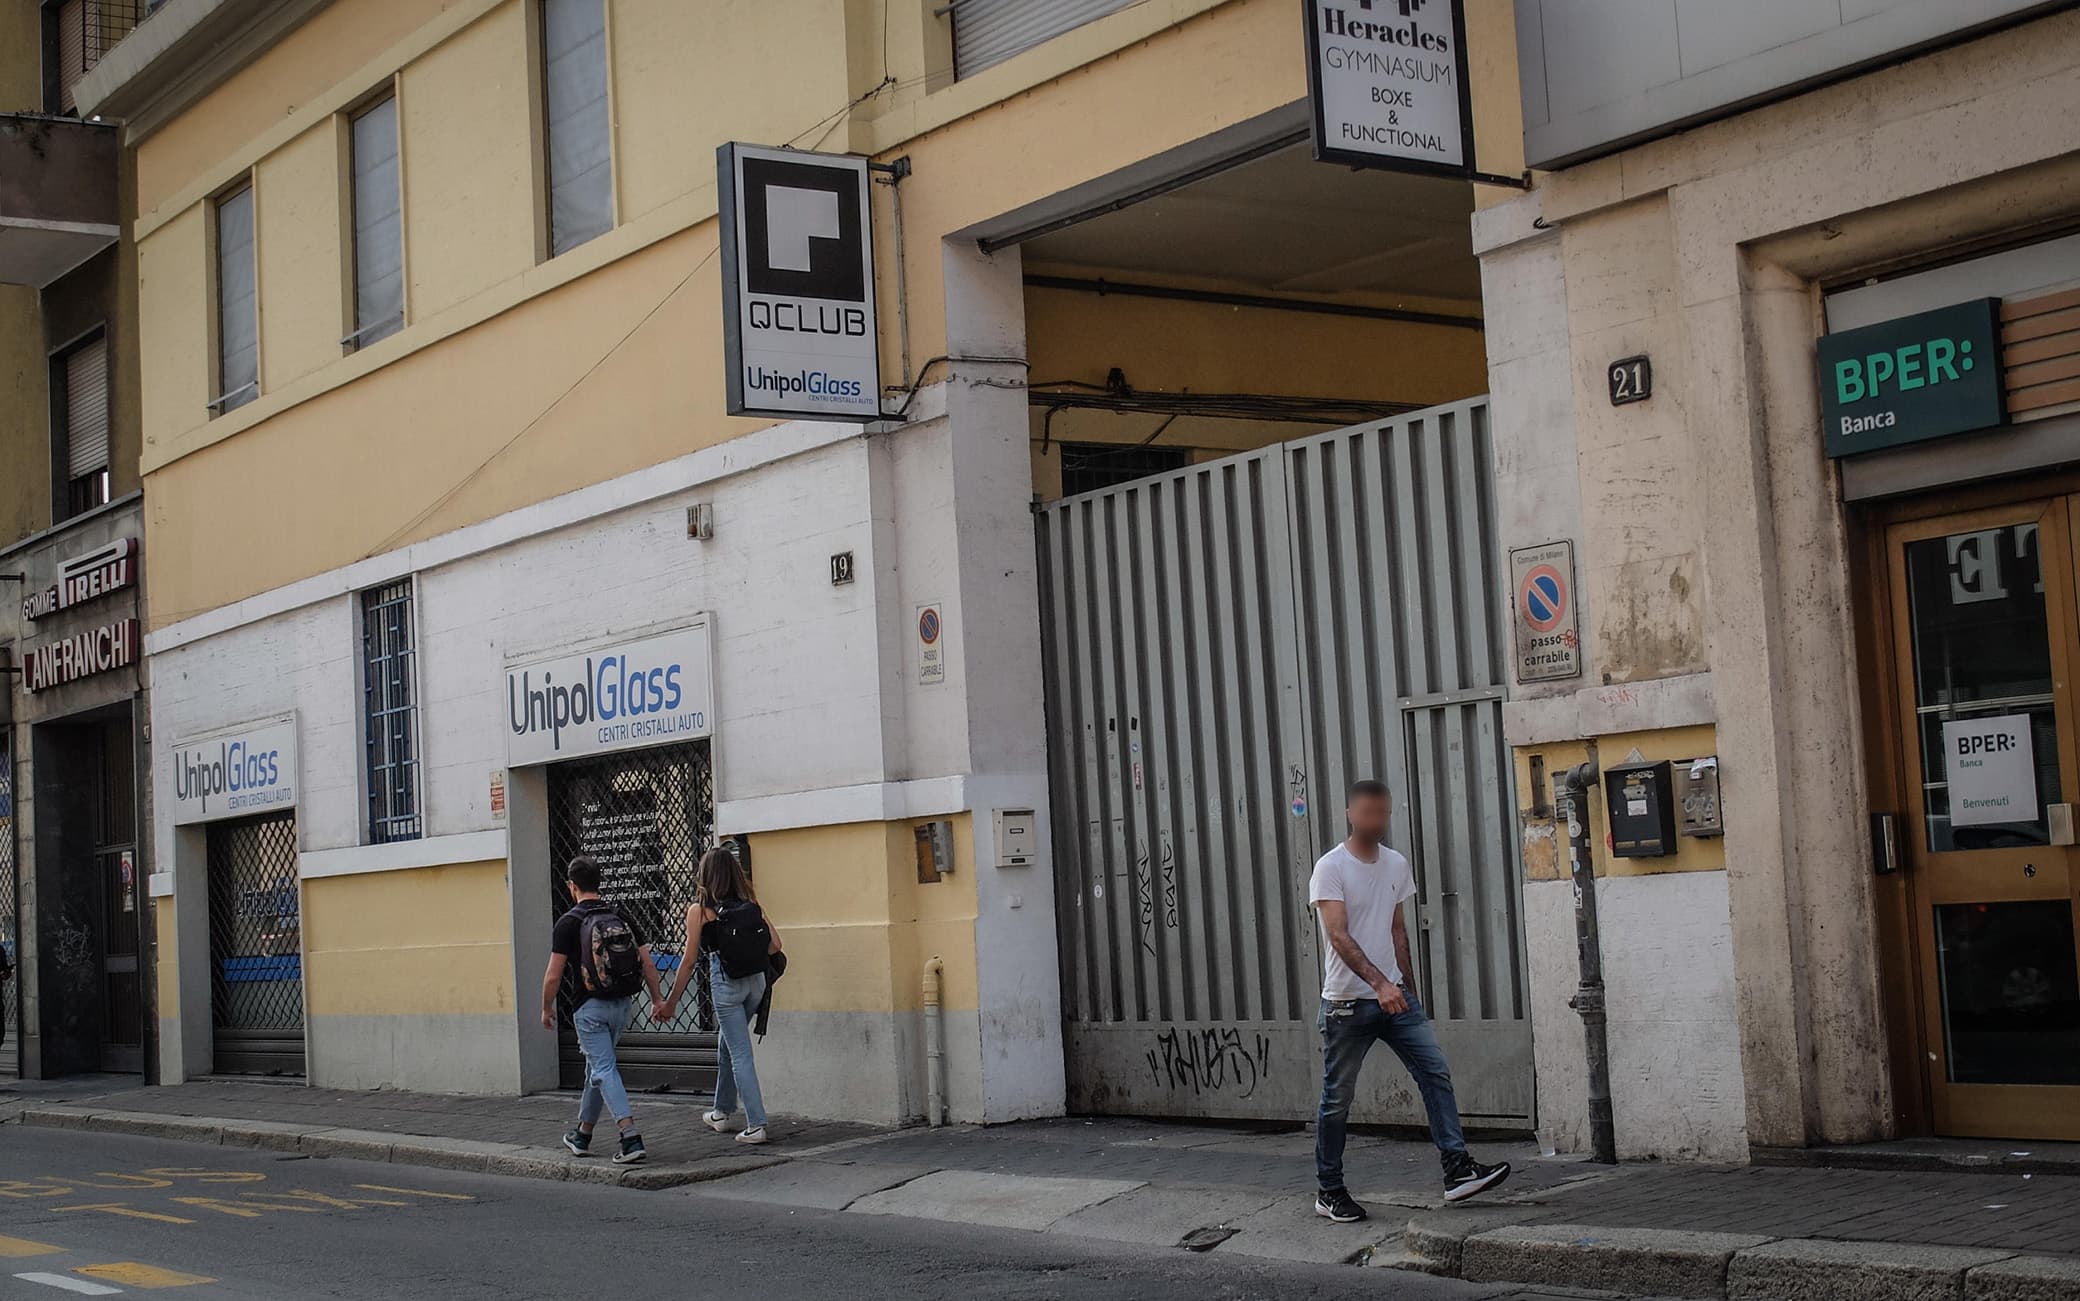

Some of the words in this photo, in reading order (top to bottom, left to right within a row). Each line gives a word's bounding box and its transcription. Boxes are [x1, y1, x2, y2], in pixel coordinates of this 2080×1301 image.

[1323, 6, 1448, 54] Heracles
[1326, 46, 1451, 86] GYMNASIUM
[1371, 86, 1413, 108] BOXE
[1388, 109, 1399, 125] &
[1342, 122, 1446, 152] FUNCTIONAL
[749, 300, 866, 337] QCLUB
[747, 366, 861, 399] UnipolGlass
[1613, 362, 1644, 398] 21
[1840, 411, 1896, 436] Banca
[22, 590, 56, 621] GOMME
[56, 537, 129, 609] PIRELLI
[831, 555, 848, 580] 19
[22, 618, 130, 695] LANFRANCHI
[1524, 650, 1570, 666] carrabile
[1530, 633, 1562, 650] passo
[509, 655, 682, 751] UnipolGlass
[598, 723, 629, 744] CENTRI
[631, 715, 676, 738] CRISTALLI
[678, 711, 704, 731] AUTO
[175, 741, 279, 814] UnipolGlass
[1959, 758, 1983, 769] Banca
[1962, 795, 2010, 809] Benvenuti
[48, 1184, 476, 1224] TAXI
